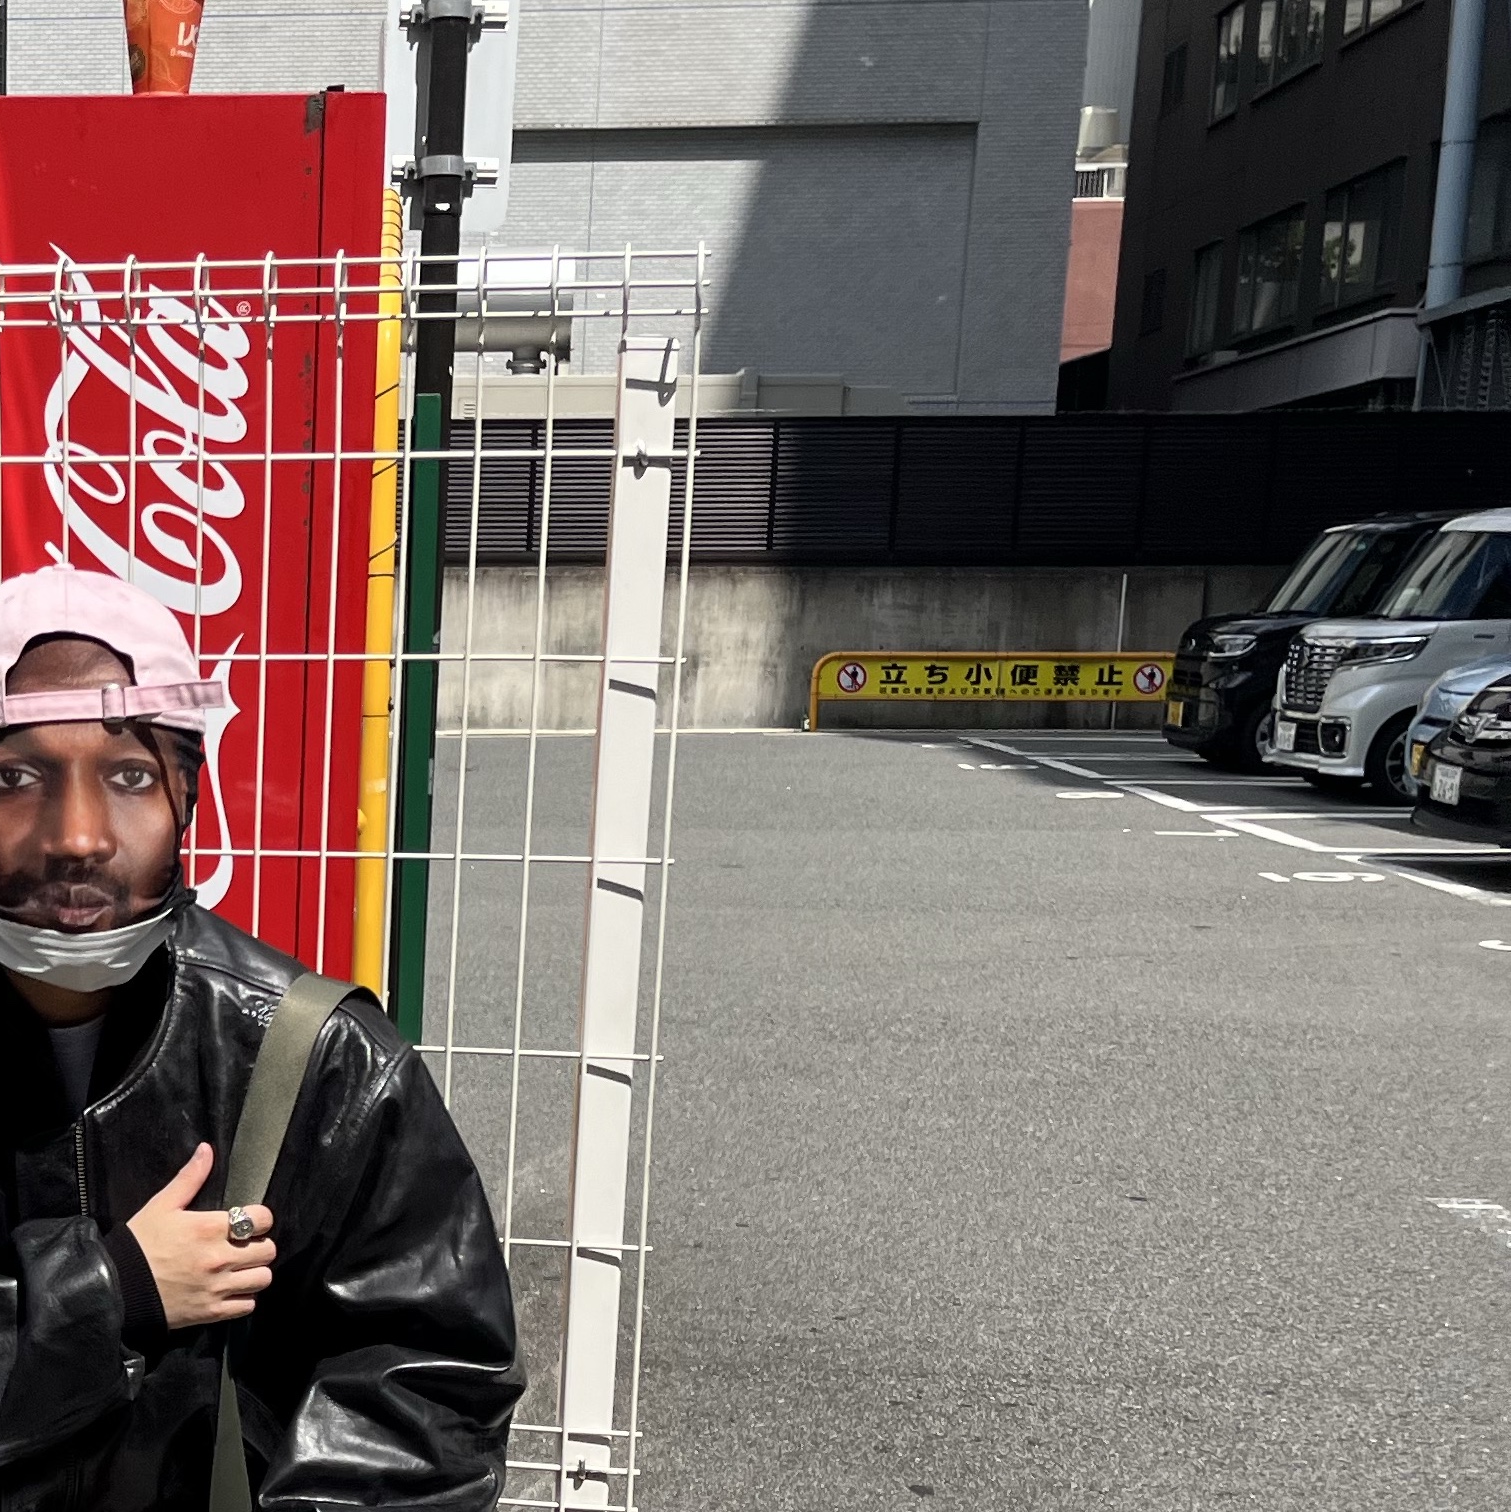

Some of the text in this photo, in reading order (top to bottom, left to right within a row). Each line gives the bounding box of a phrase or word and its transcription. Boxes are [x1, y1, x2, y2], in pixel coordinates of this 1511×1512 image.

[879, 663, 1123, 686] 立ち小便禁止
